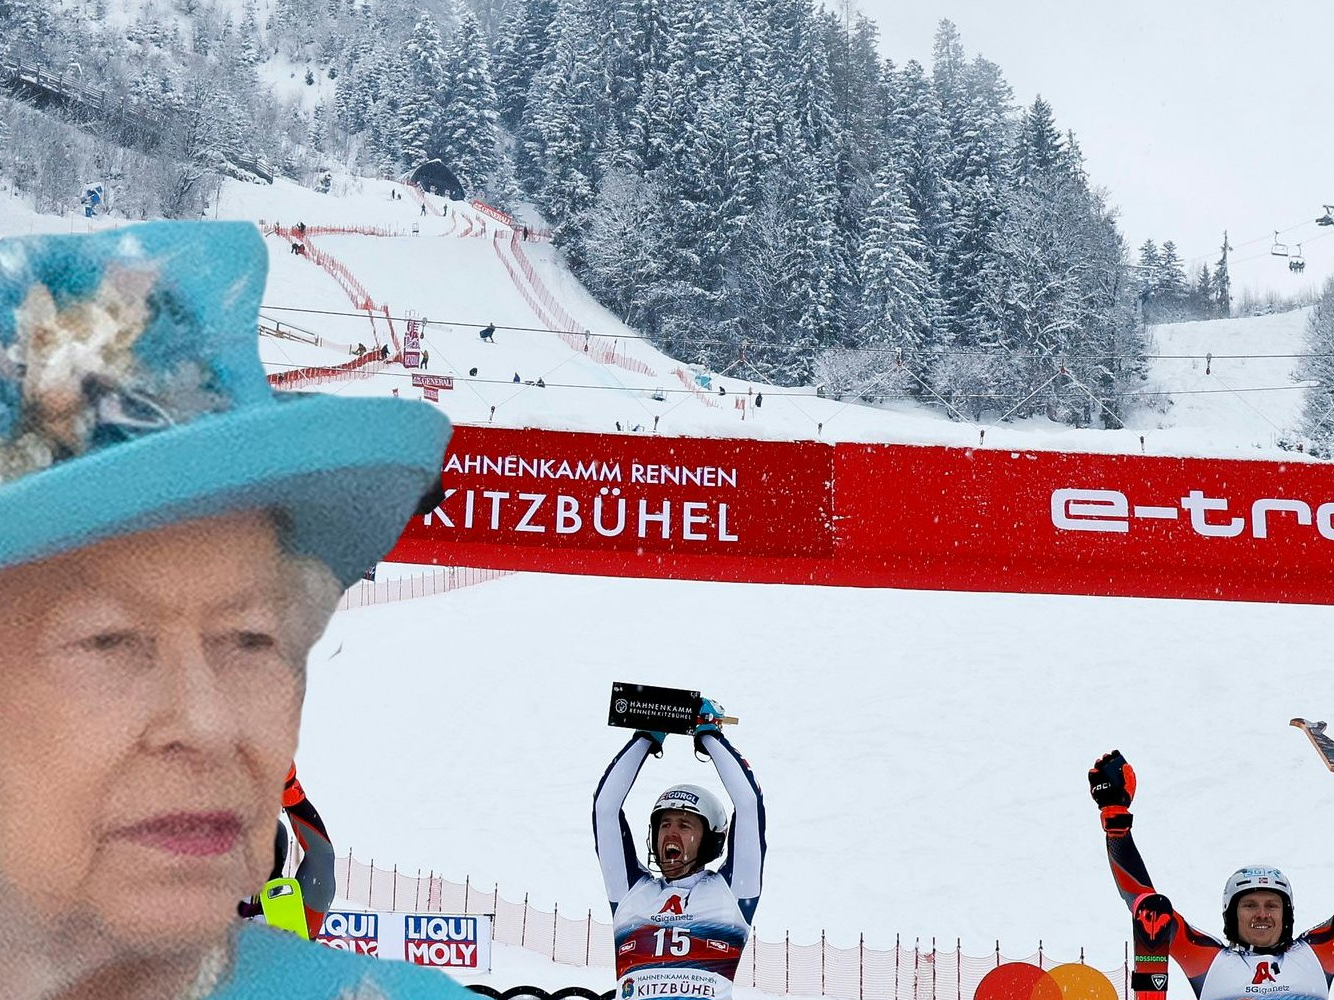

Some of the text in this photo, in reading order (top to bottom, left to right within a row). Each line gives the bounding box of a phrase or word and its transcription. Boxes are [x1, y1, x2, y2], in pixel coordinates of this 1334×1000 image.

[444, 454, 737, 487] AHNENKAMM RENNEN
[424, 488, 738, 542] KITZBÜHEL
[630, 701, 692, 714] HAHNENKAMM
[319, 914, 375, 937] IQUI
[408, 917, 475, 942] LIQUI
[653, 927, 691, 957] 15
[408, 943, 477, 966] MOLY
[1135, 955, 1168, 963] ROSSIGNOL
[638, 973, 689, 982] HAHNENKAMM
[638, 981, 715, 997] KITZBÜHEL
[1245, 985, 1290, 994] 5Giganetz
